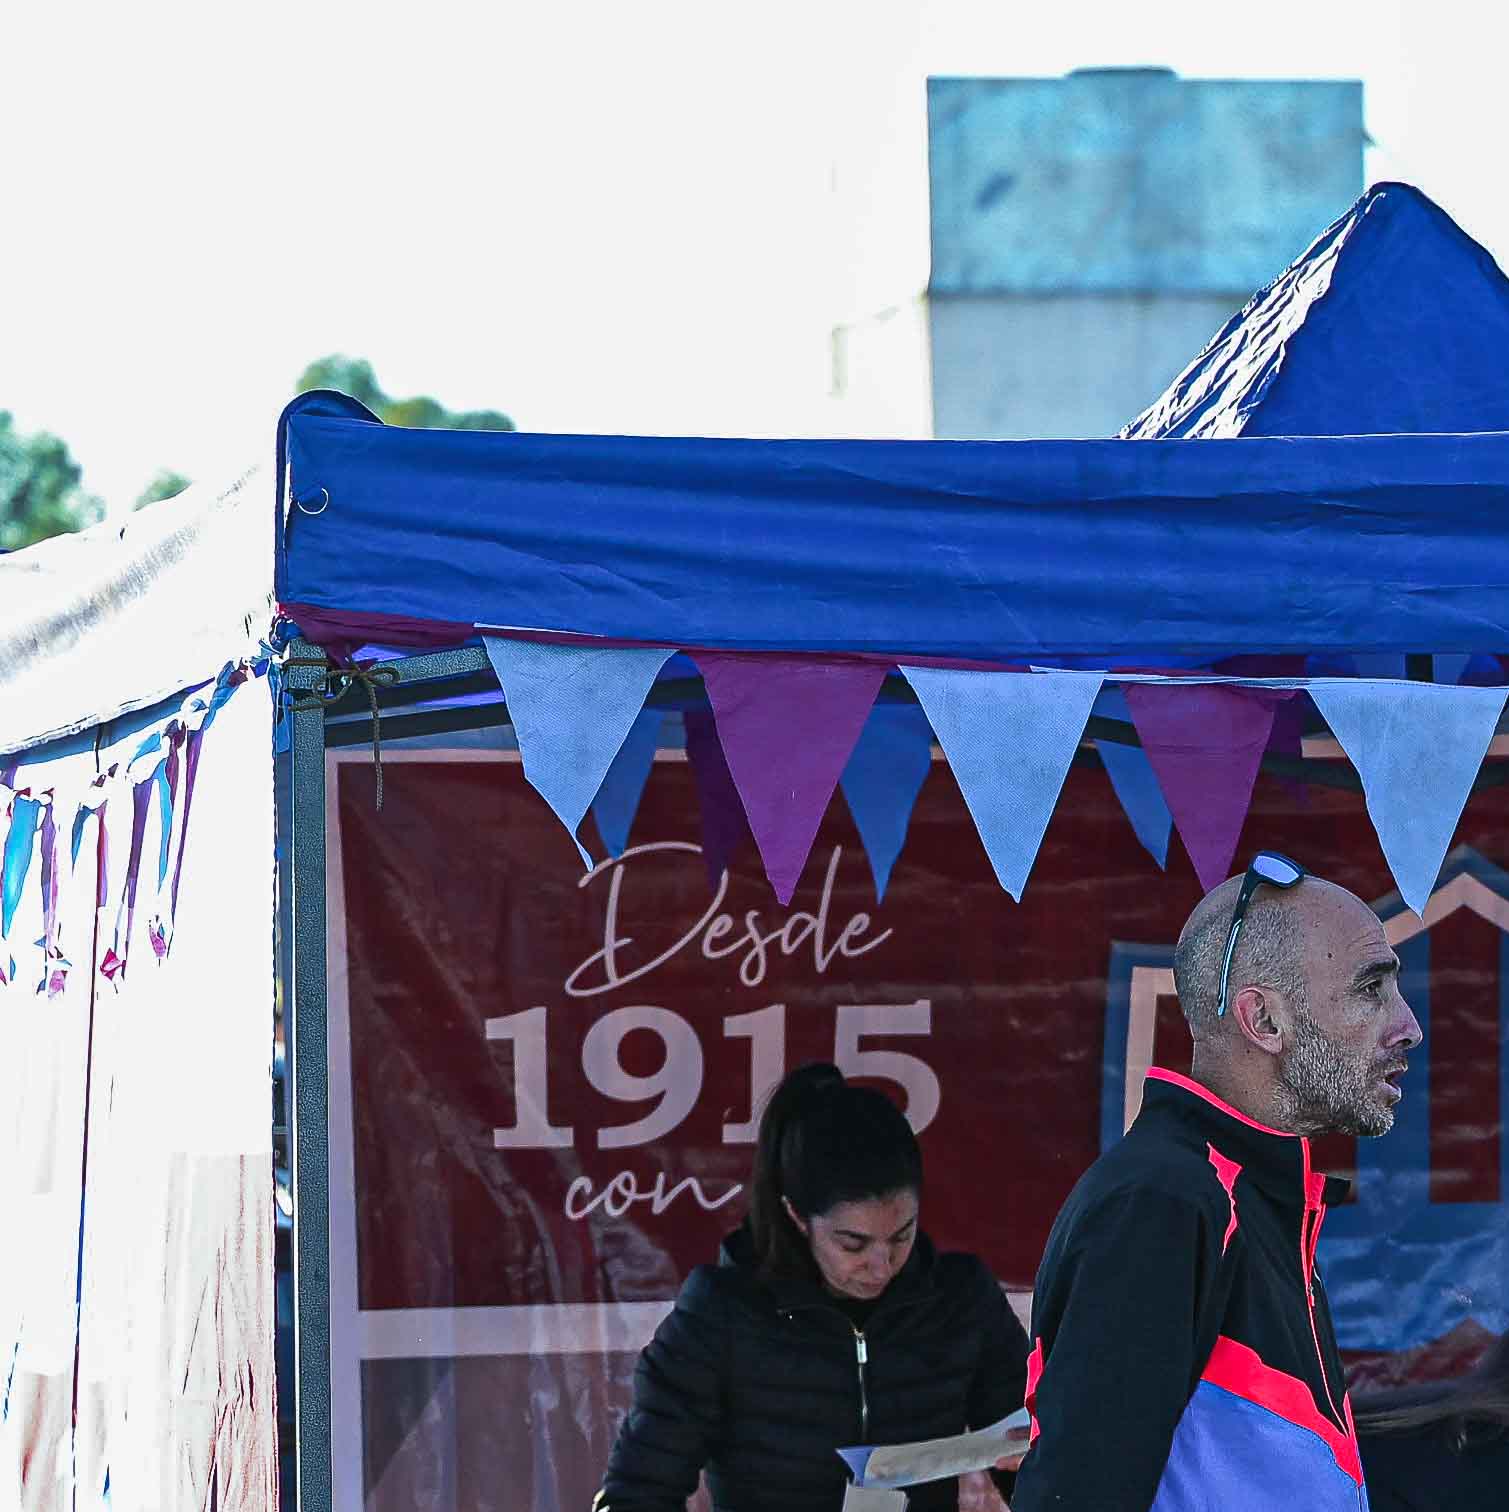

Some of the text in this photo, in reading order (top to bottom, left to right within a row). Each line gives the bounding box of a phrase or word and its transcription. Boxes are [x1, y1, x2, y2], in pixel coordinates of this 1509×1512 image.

[564, 839, 893, 997] Desde
[484, 998, 942, 1150] 1915
[564, 1166, 742, 1221] con
